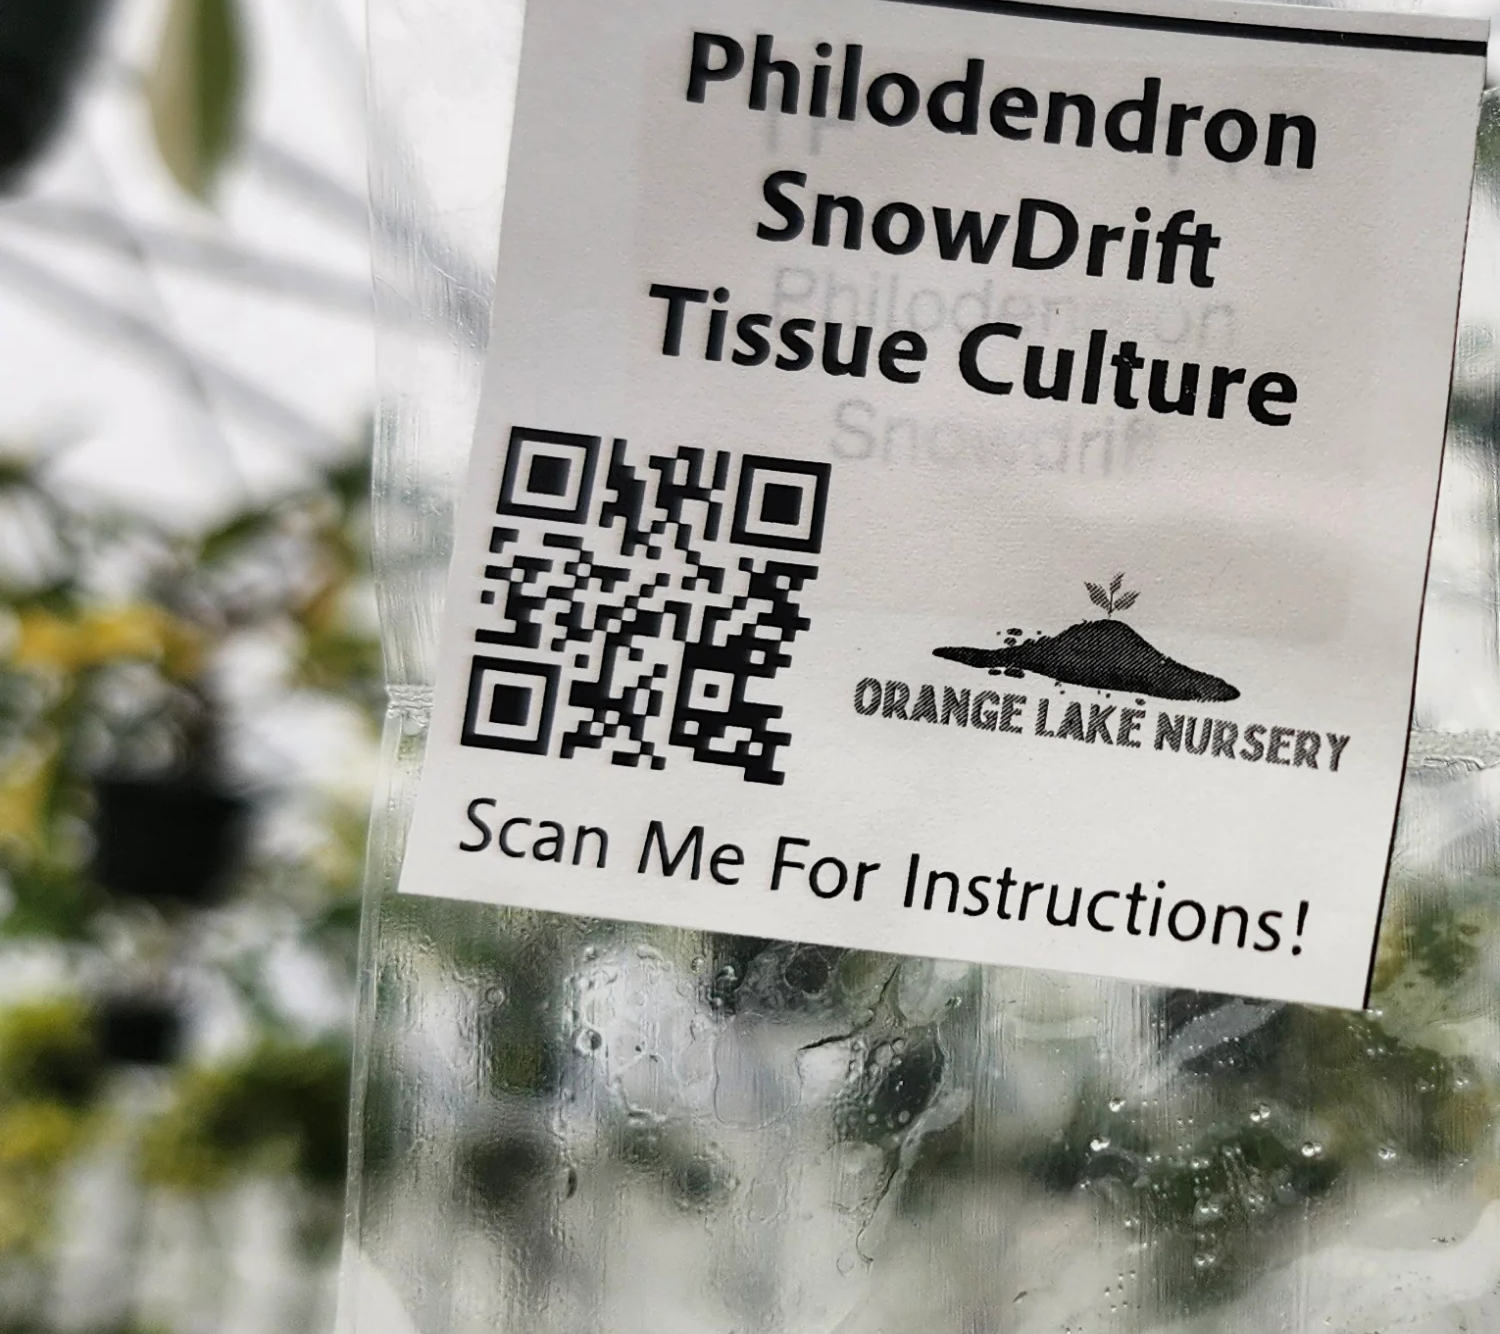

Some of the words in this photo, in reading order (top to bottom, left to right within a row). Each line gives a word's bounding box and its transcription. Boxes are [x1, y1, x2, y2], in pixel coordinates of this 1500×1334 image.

[684, 30, 1319, 171] Philodendron
[754, 168, 1224, 290] SnowDrift
[647, 281, 929, 385] Tissue
[957, 320, 1300, 428] Culture
[852, 676, 1029, 735] ORANGE
[1034, 697, 1148, 749] LAKE
[1152, 711, 1352, 773] NURSERY
[458, 796, 610, 870] Scan
[636, 818, 746, 887] Me
[769, 834, 882, 903] For
[902, 852, 1311, 958] Instructions!
